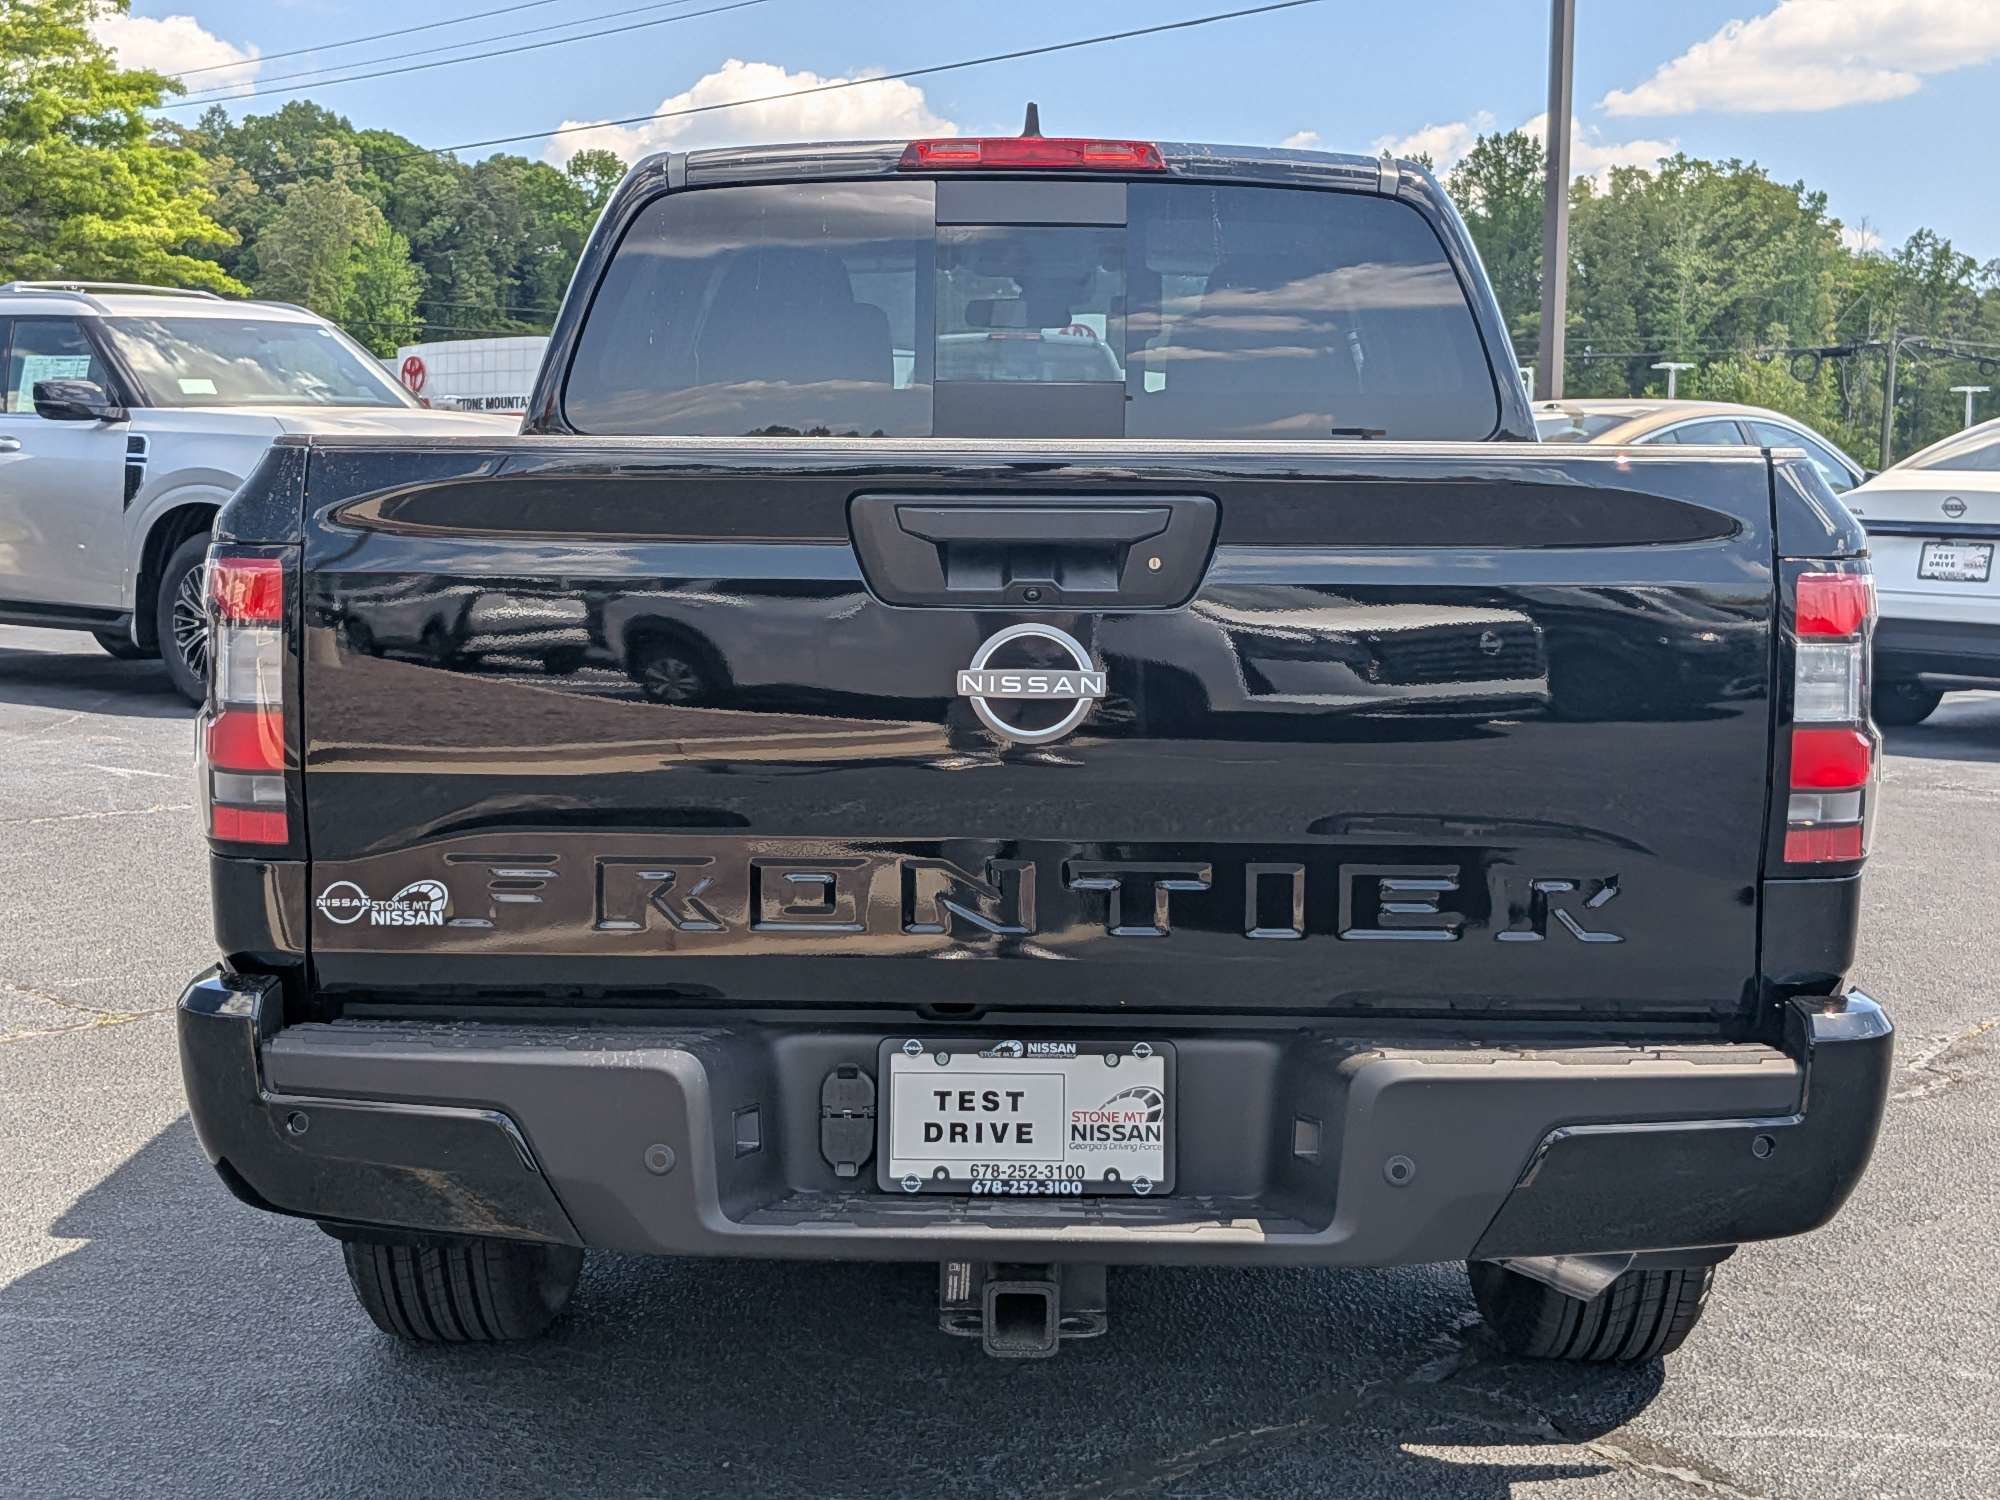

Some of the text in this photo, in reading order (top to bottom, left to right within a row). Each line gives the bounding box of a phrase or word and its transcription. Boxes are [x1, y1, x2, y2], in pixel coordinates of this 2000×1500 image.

[485, 396, 530, 410] MOUNTA
[962, 675, 1101, 694] NISSAN
[316, 898, 371, 907] NISSAN
[371, 900, 430, 911] STONE MT
[445, 853, 1625, 943] FRONTIER
[370, 911, 443, 926] NISSAN
[1027, 1042, 1076, 1054] NISSAN
[933, 1090, 1025, 1112] TEST
[1071, 1111, 1145, 1123] STONE MT
[923, 1122, 1033, 1144] DRIVE
[1070, 1123, 1161, 1142] NISSAN
[1108, 1142, 1138, 1152] Driving
[970, 1163, 1086, 1179] 678-252-3100
[971, 1180, 1083, 1195] 678-252-3100
